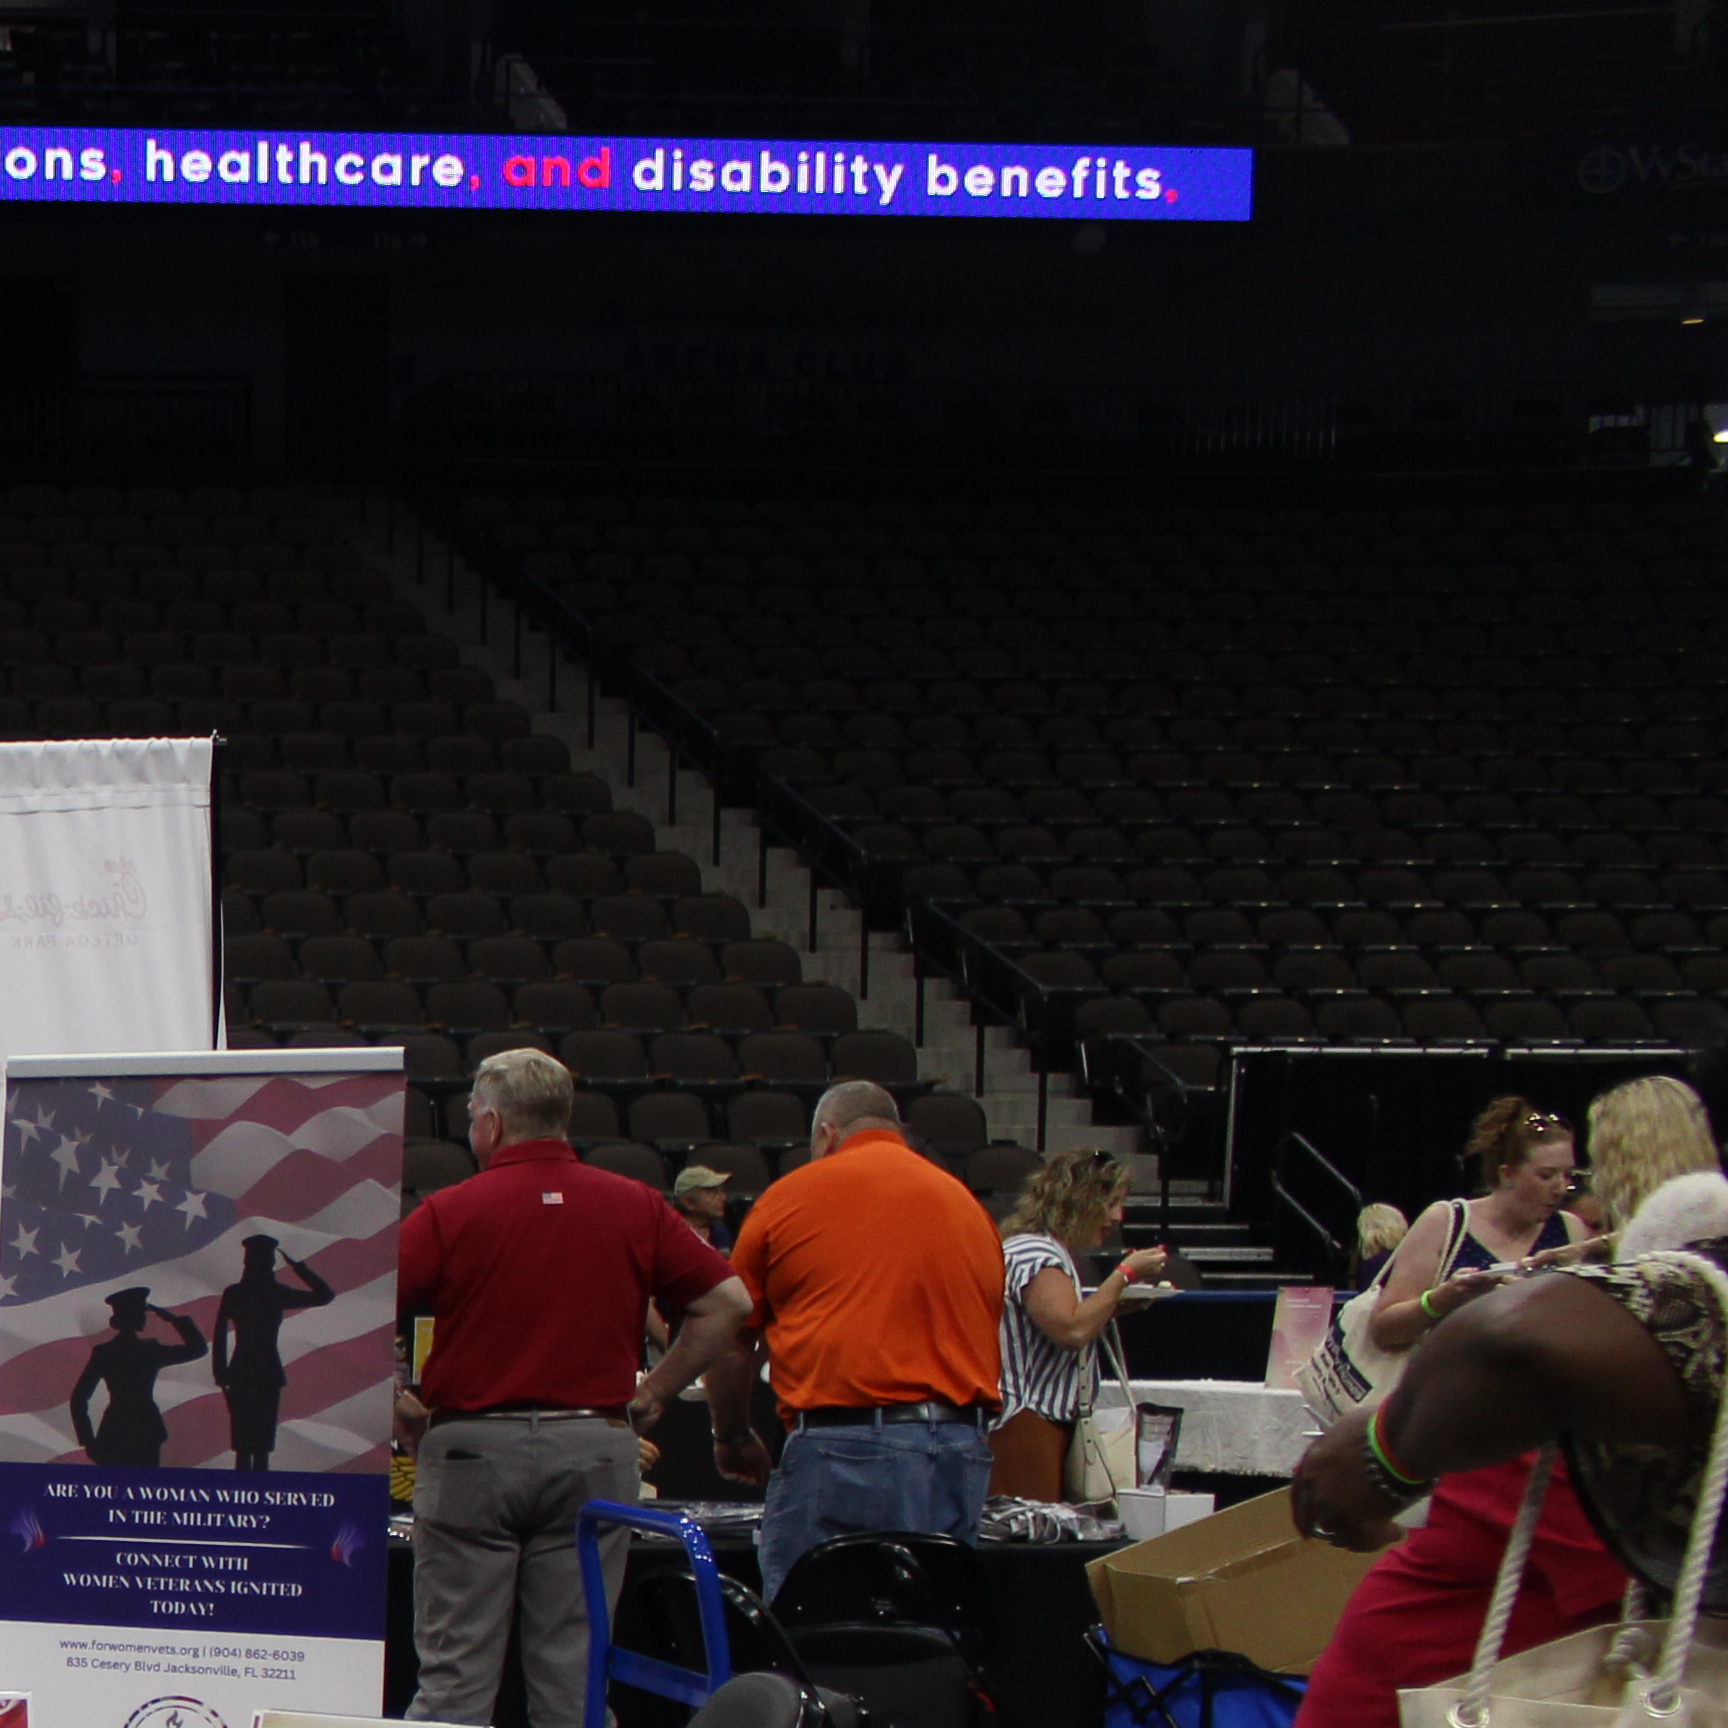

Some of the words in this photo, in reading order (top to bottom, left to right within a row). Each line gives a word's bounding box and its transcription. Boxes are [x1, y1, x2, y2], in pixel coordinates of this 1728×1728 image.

[145, 139, 480, 190] healthcare,
[503, 147, 610, 189] and
[632, 149, 903, 205] disability
[926, 153, 1178, 204] benefits.
[44, 1483, 79, 1499] ARE
[83, 1484, 118, 1500] YOU
[124, 1486, 134, 1501] A
[139, 1486, 211, 1504] WOMAN
[216, 1489, 258, 1506] WHO
[263, 1490, 335, 1508] SERVED
[107, 1508, 128, 1523] IN
[132, 1509, 168, 1525] THE
[172, 1511, 271, 1530] MILITARY?
[115, 1551, 197, 1569] CONNECT
[201, 1555, 249, 1571] WITH
[62, 1572, 131, 1589] WOMEN
[135, 1575, 226, 1594] VETERANS
[230, 1579, 303, 1598] IGNITED
[150, 1600, 215, 1617] TODAY!
[59, 1638, 200, 1658] www.forwomenvets.org
[209, 1644, 242, 1661] (904)
[245, 1646, 305, 1662] 862-6039
[66, 1656, 88, 1669] 835
[91, 1657, 132, 1674] Cesery
[133, 1658, 161, 1673] Blvd
[163, 1660, 242, 1680] Jacksonville,
[244, 1666, 258, 1678] FL
[261, 1667, 296, 1681] 32211
